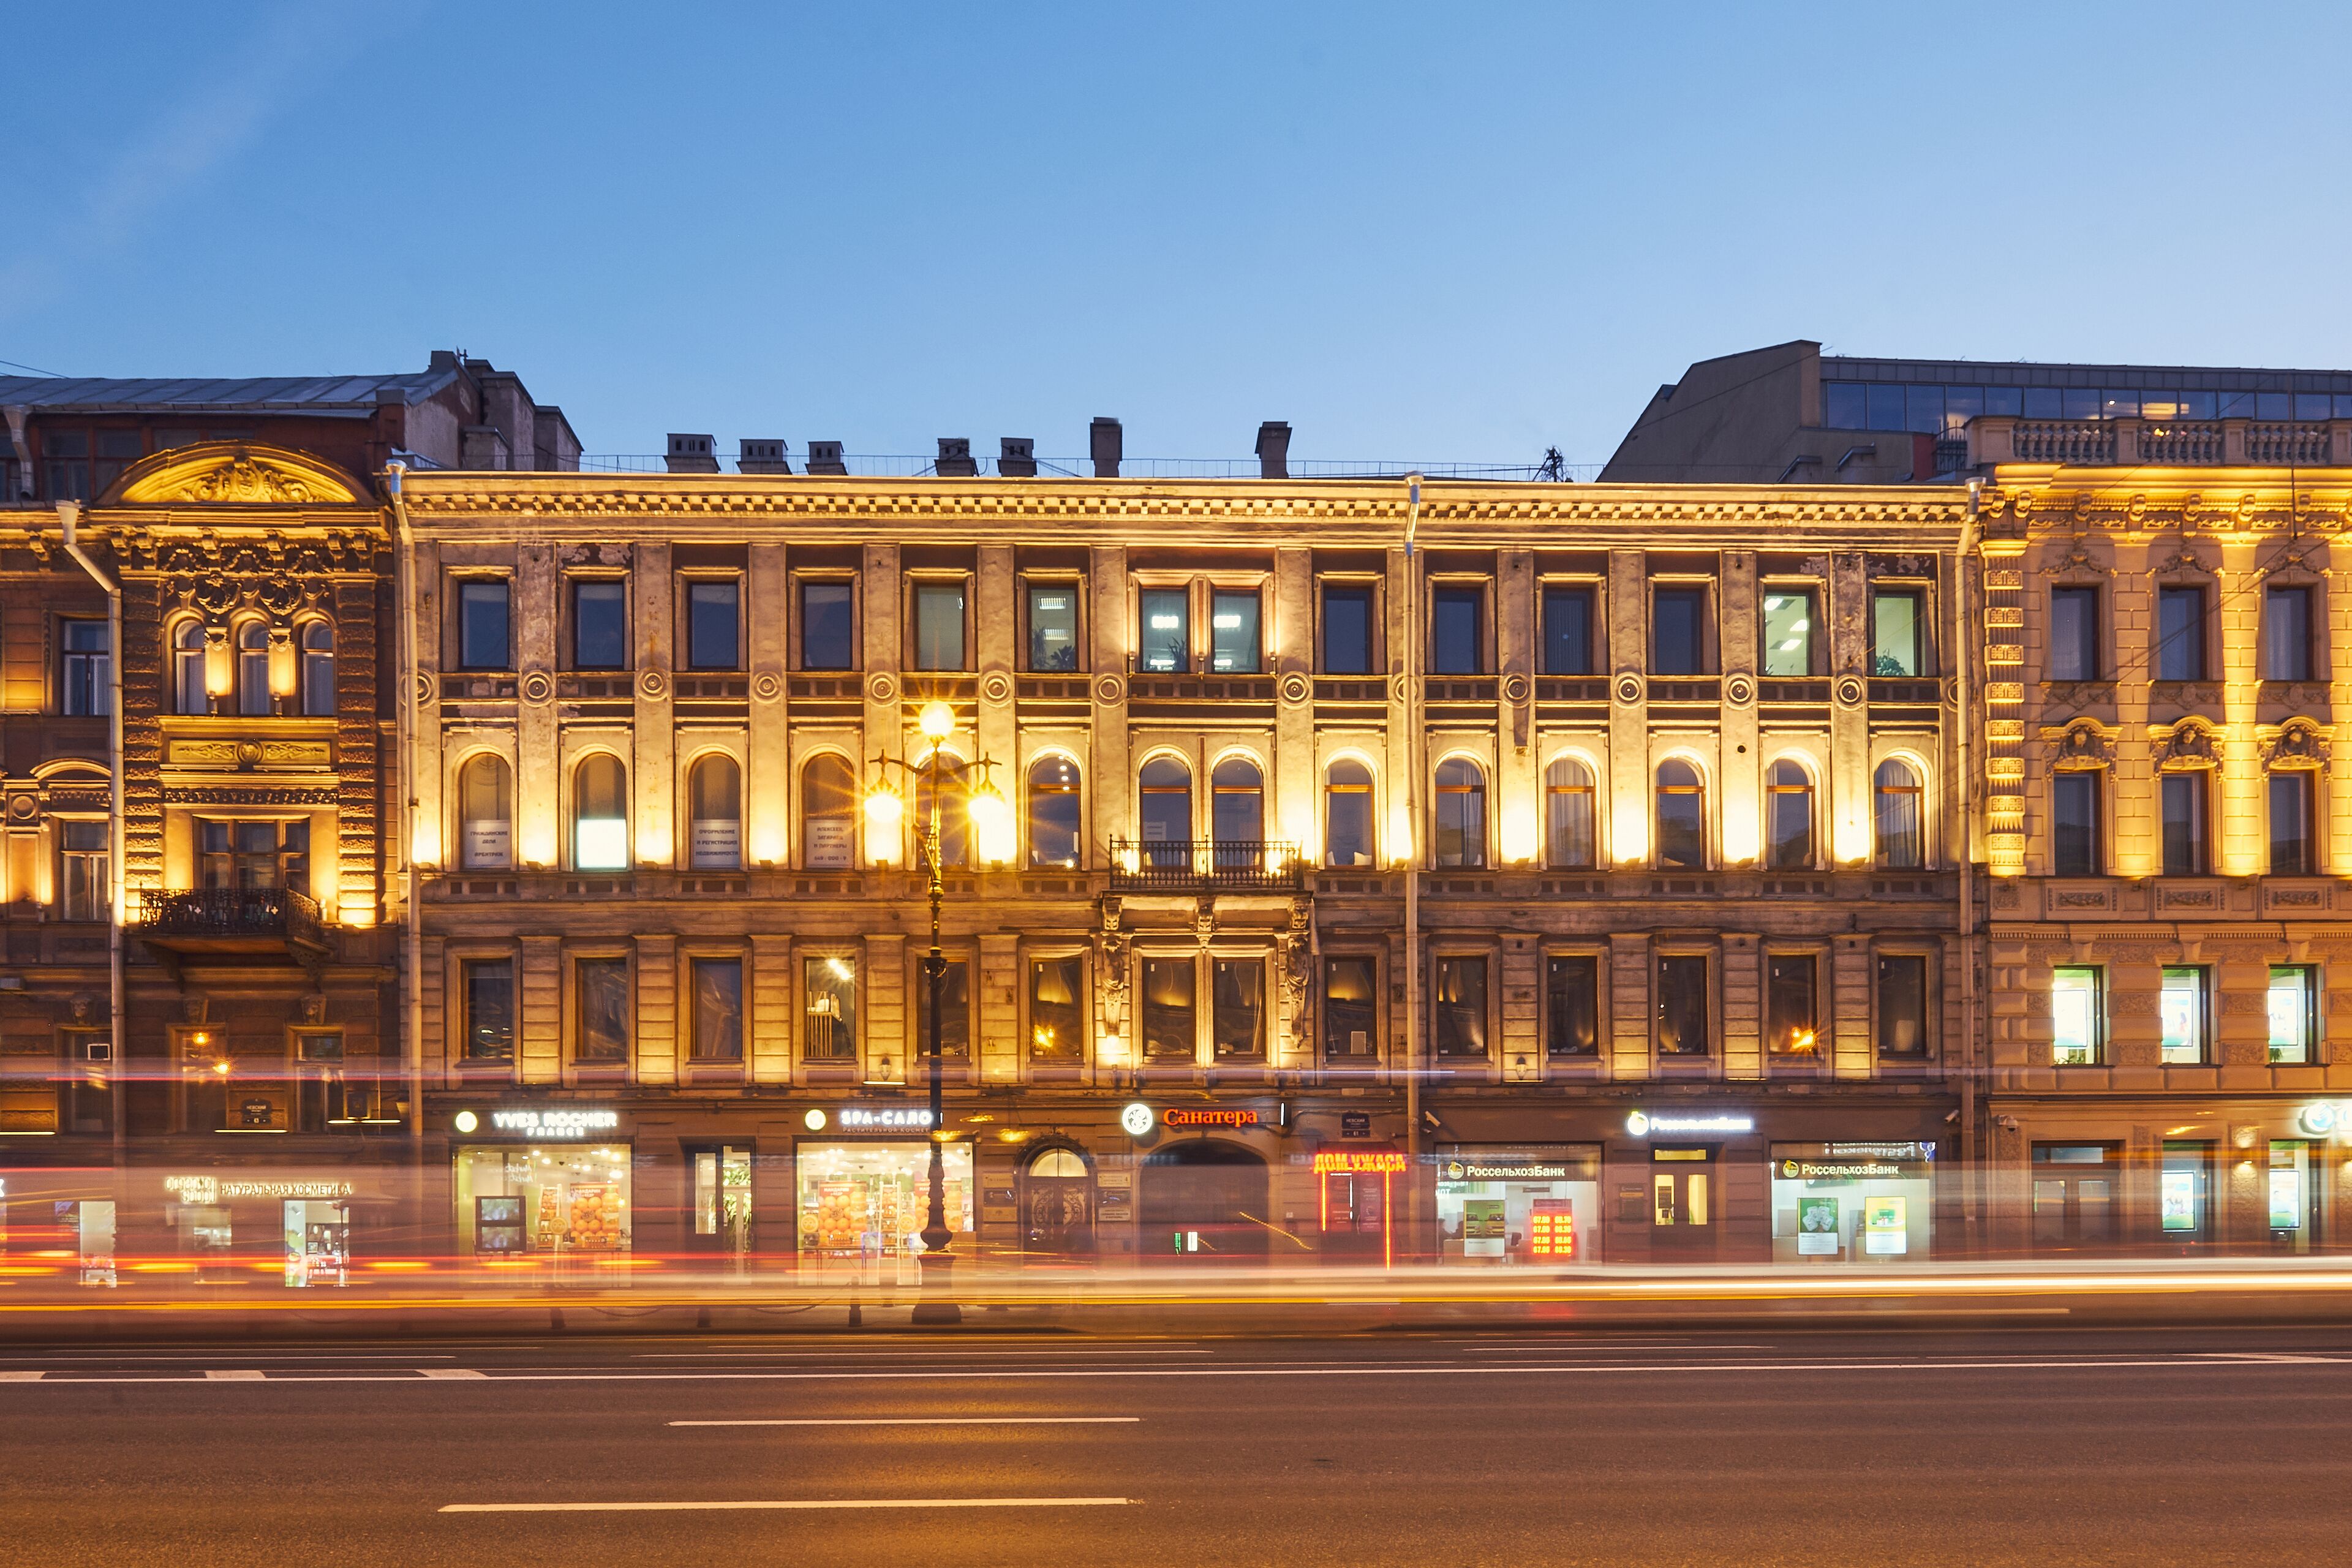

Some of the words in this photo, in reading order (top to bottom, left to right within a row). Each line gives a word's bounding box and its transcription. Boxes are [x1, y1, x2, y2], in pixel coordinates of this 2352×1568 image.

[494, 1112, 539, 1127] YVES
[543, 1112, 617, 1127] ROCHER
[1164, 1109, 1258, 1128] Санатера
[1314, 1153, 1349, 1174] ДОМ
[1802, 1164, 1899, 1175] РоссельхозБанк
[1467, 1166, 1565, 1177] РоссельхозБанк
[221, 1185, 288, 1195] НАТУРАЛЬНАЯ
[292, 1185, 350, 1195] КОСМЕТИКА
